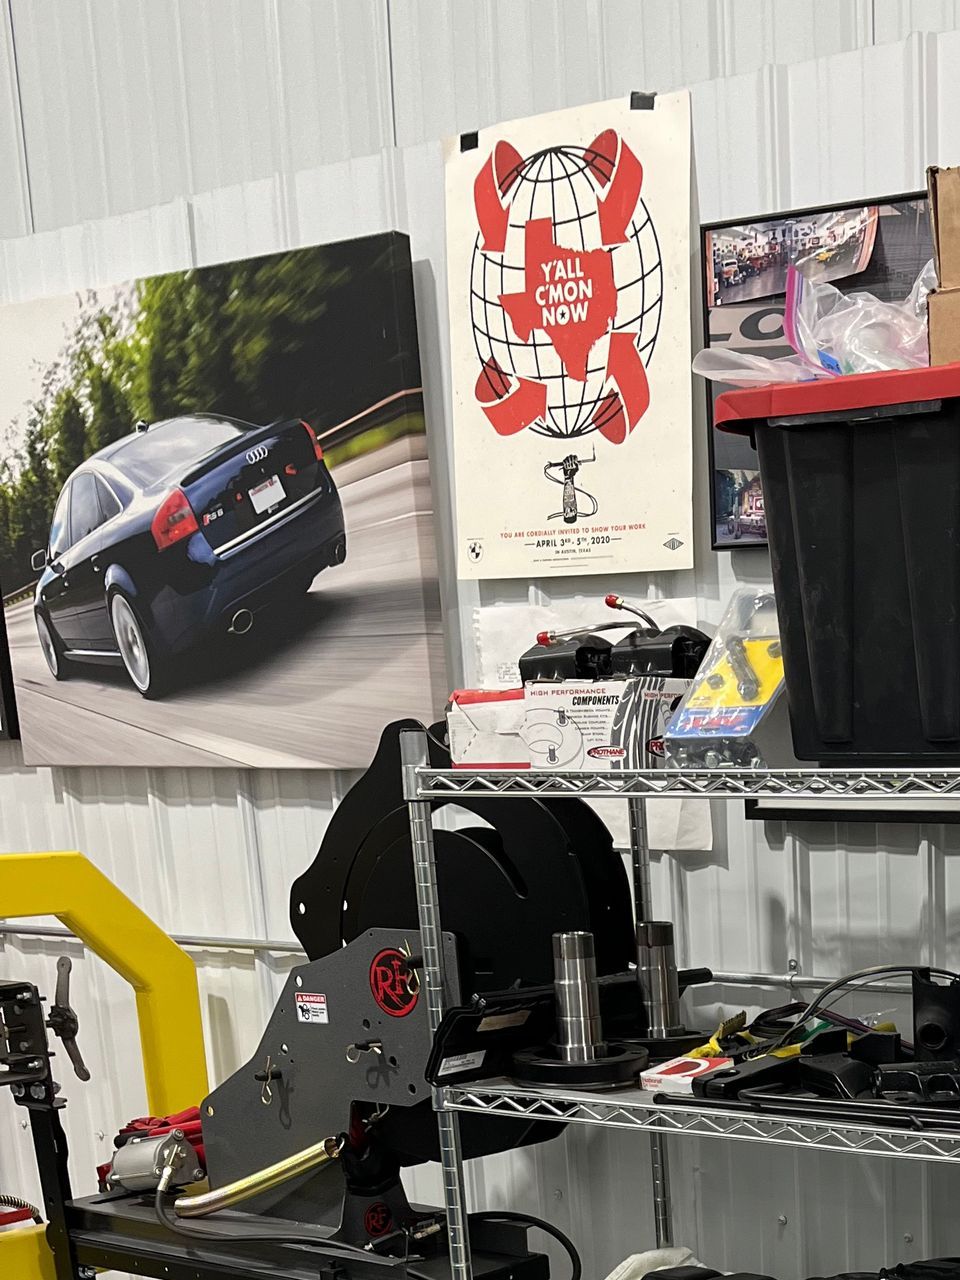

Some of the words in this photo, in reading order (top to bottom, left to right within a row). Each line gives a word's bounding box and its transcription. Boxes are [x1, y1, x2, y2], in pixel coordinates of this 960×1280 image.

[541, 257, 585, 282] Y'ALL
[535, 278, 593, 306] C'MON
[542, 300, 589, 327] NOW
[500, 531, 513, 539] YOU
[514, 530, 525, 538] ARE
[526, 527, 556, 538] CORDIALLY
[558, 526, 580, 535] INVITED
[582, 526, 590, 534] TO
[591, 524, 609, 533] SHOW
[611, 523, 627, 532] YOUR
[628, 522, 646, 531] WORK
[536, 537, 558, 548] APRIL
[591, 535, 611, 545] 2020
[551, 688, 606, 696] PERFORMANCE
[572, 695, 620, 706] COMPONENTS
[302, 994, 325, 1003] DANGER
